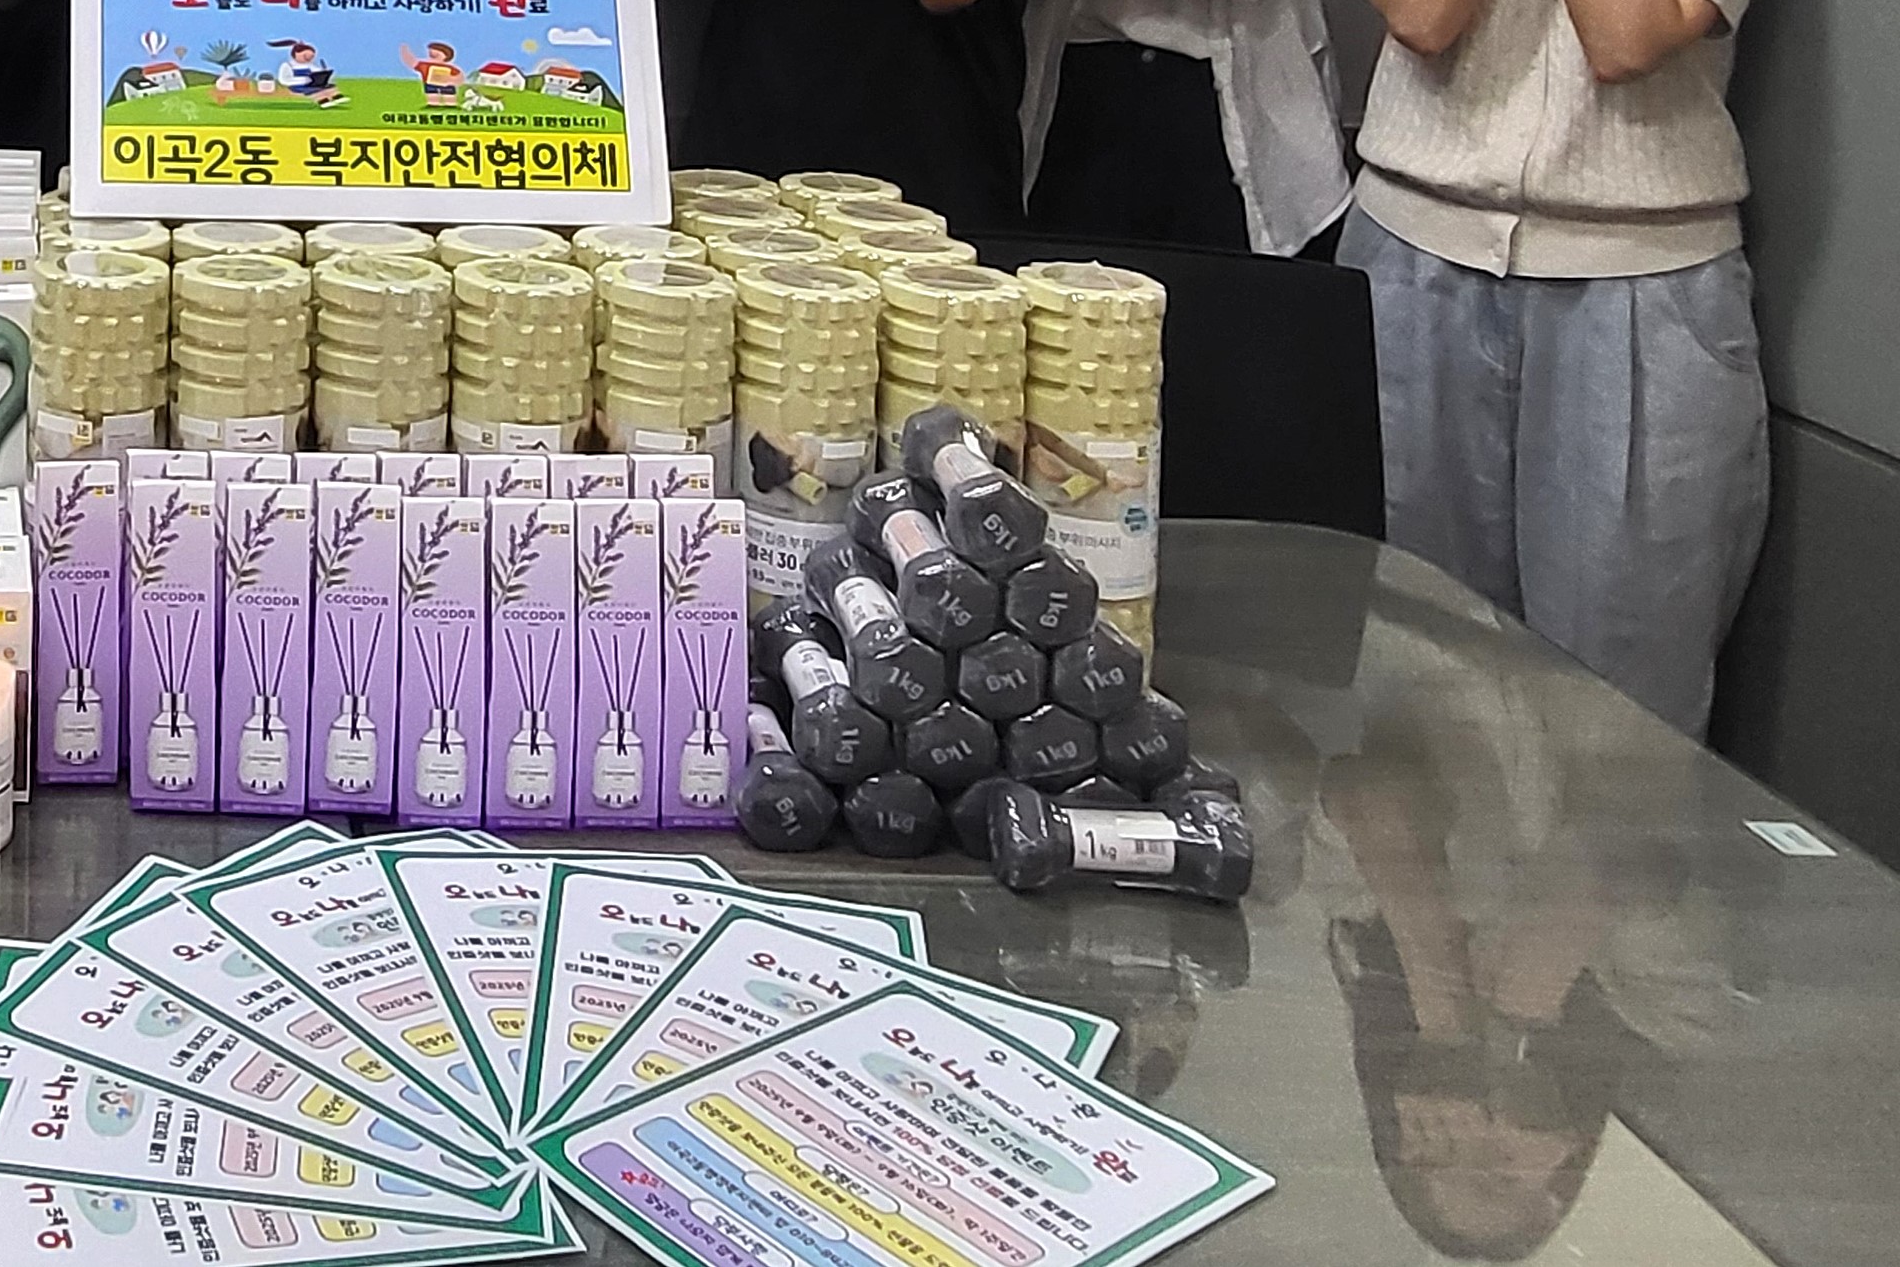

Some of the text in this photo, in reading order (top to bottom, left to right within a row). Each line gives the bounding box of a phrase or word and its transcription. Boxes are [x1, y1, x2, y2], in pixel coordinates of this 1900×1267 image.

[114, 133, 618, 189] 이곡2동 복지안전협의체
[48, 569, 111, 581] COCODOR
[141, 592, 206, 603] COCODOR
[236, 594, 300, 606] COCODOR
[324, 593, 389, 606] COCODOR
[412, 608, 476, 619] COCODOR
[502, 610, 566, 621] COCODOR
[588, 610, 651, 621] COCODOR
[675, 610, 738, 621] COCODOR
